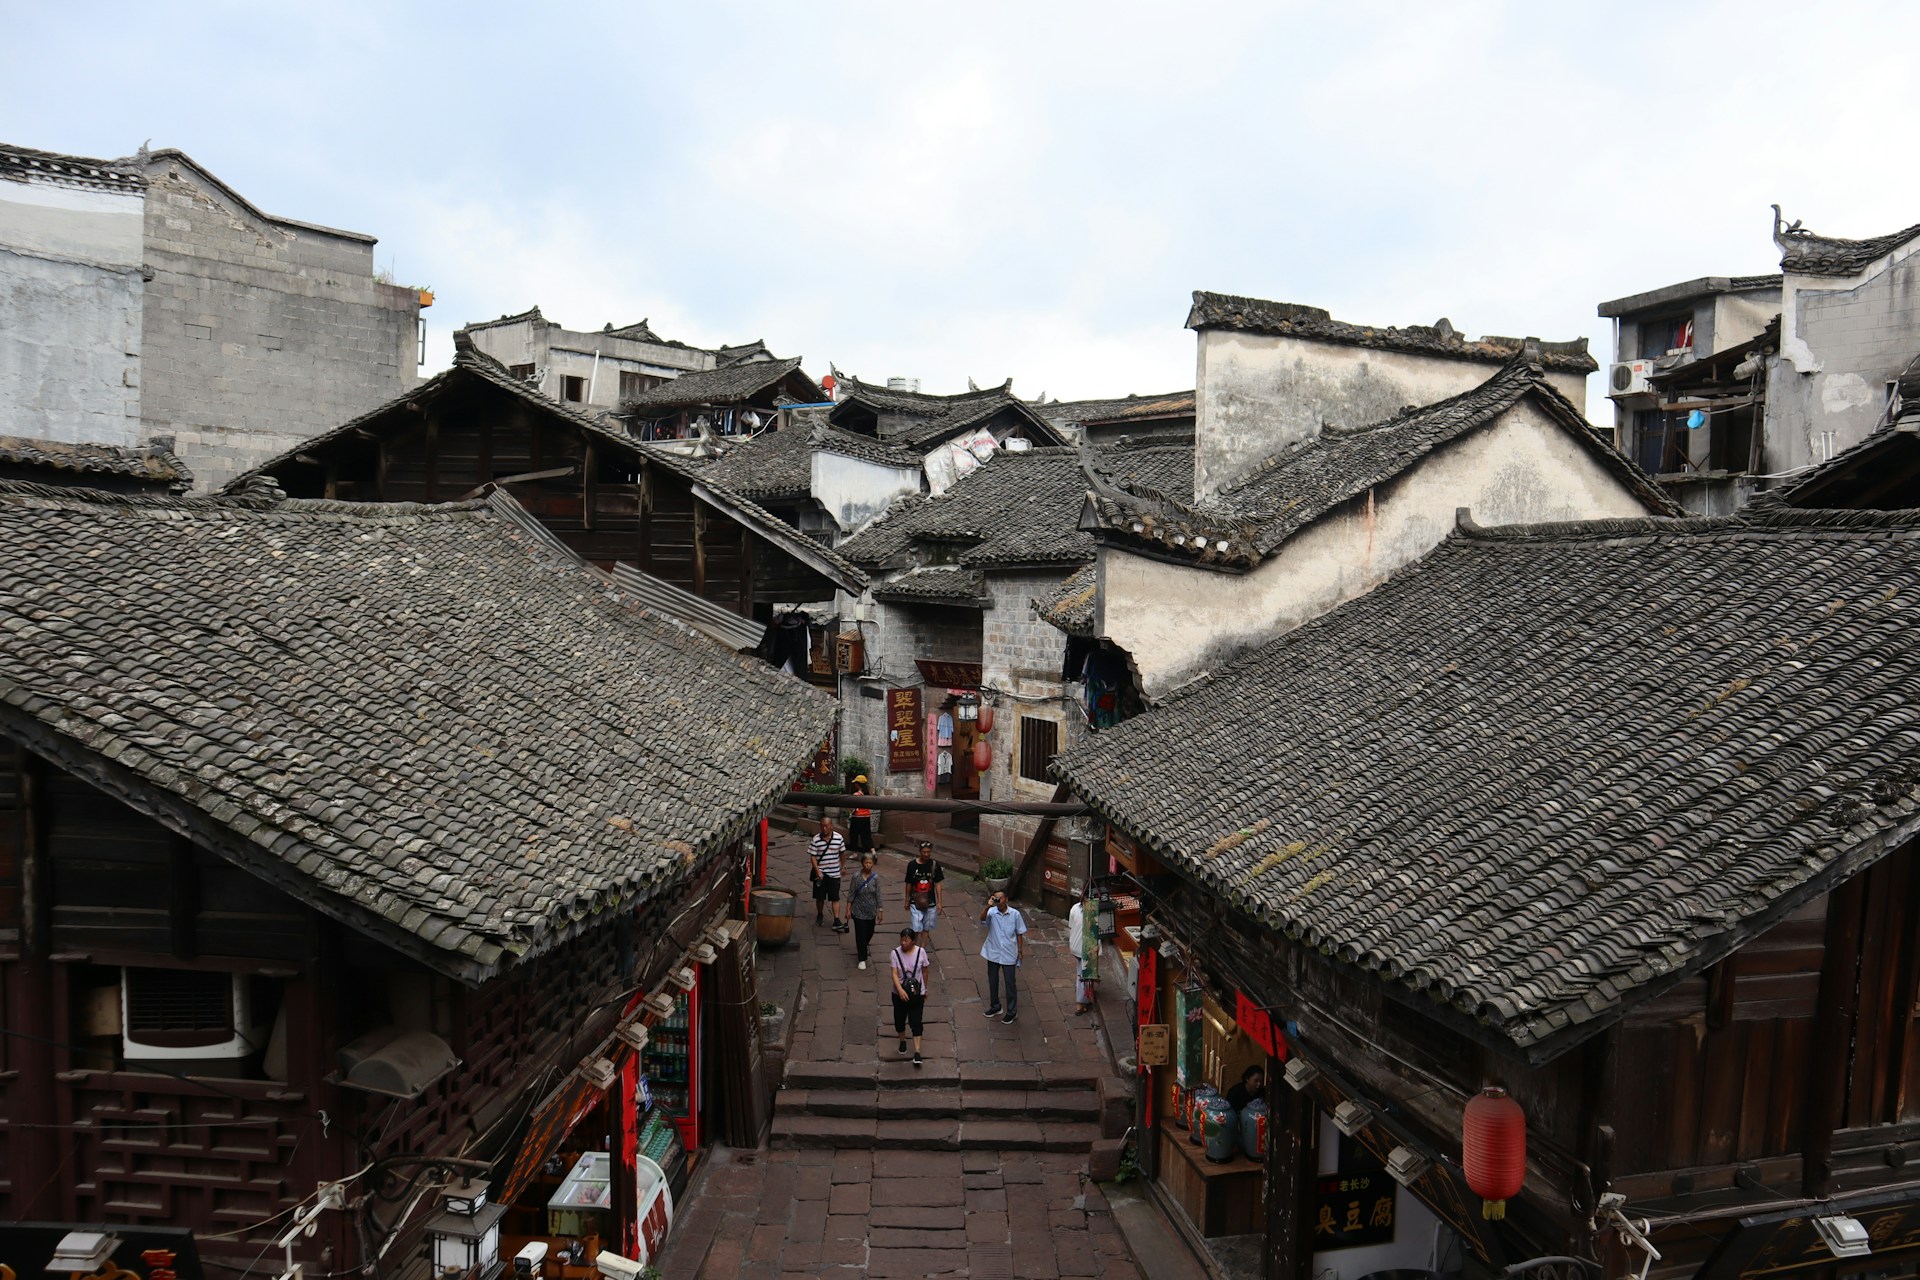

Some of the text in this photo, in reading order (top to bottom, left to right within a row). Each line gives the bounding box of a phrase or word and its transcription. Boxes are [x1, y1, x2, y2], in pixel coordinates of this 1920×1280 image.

[893, 691, 917, 747] 翠翠屋
[1338, 1176, 1371, 1192] 老长沙
[1314, 1196, 1393, 1237] 臭豆腐
